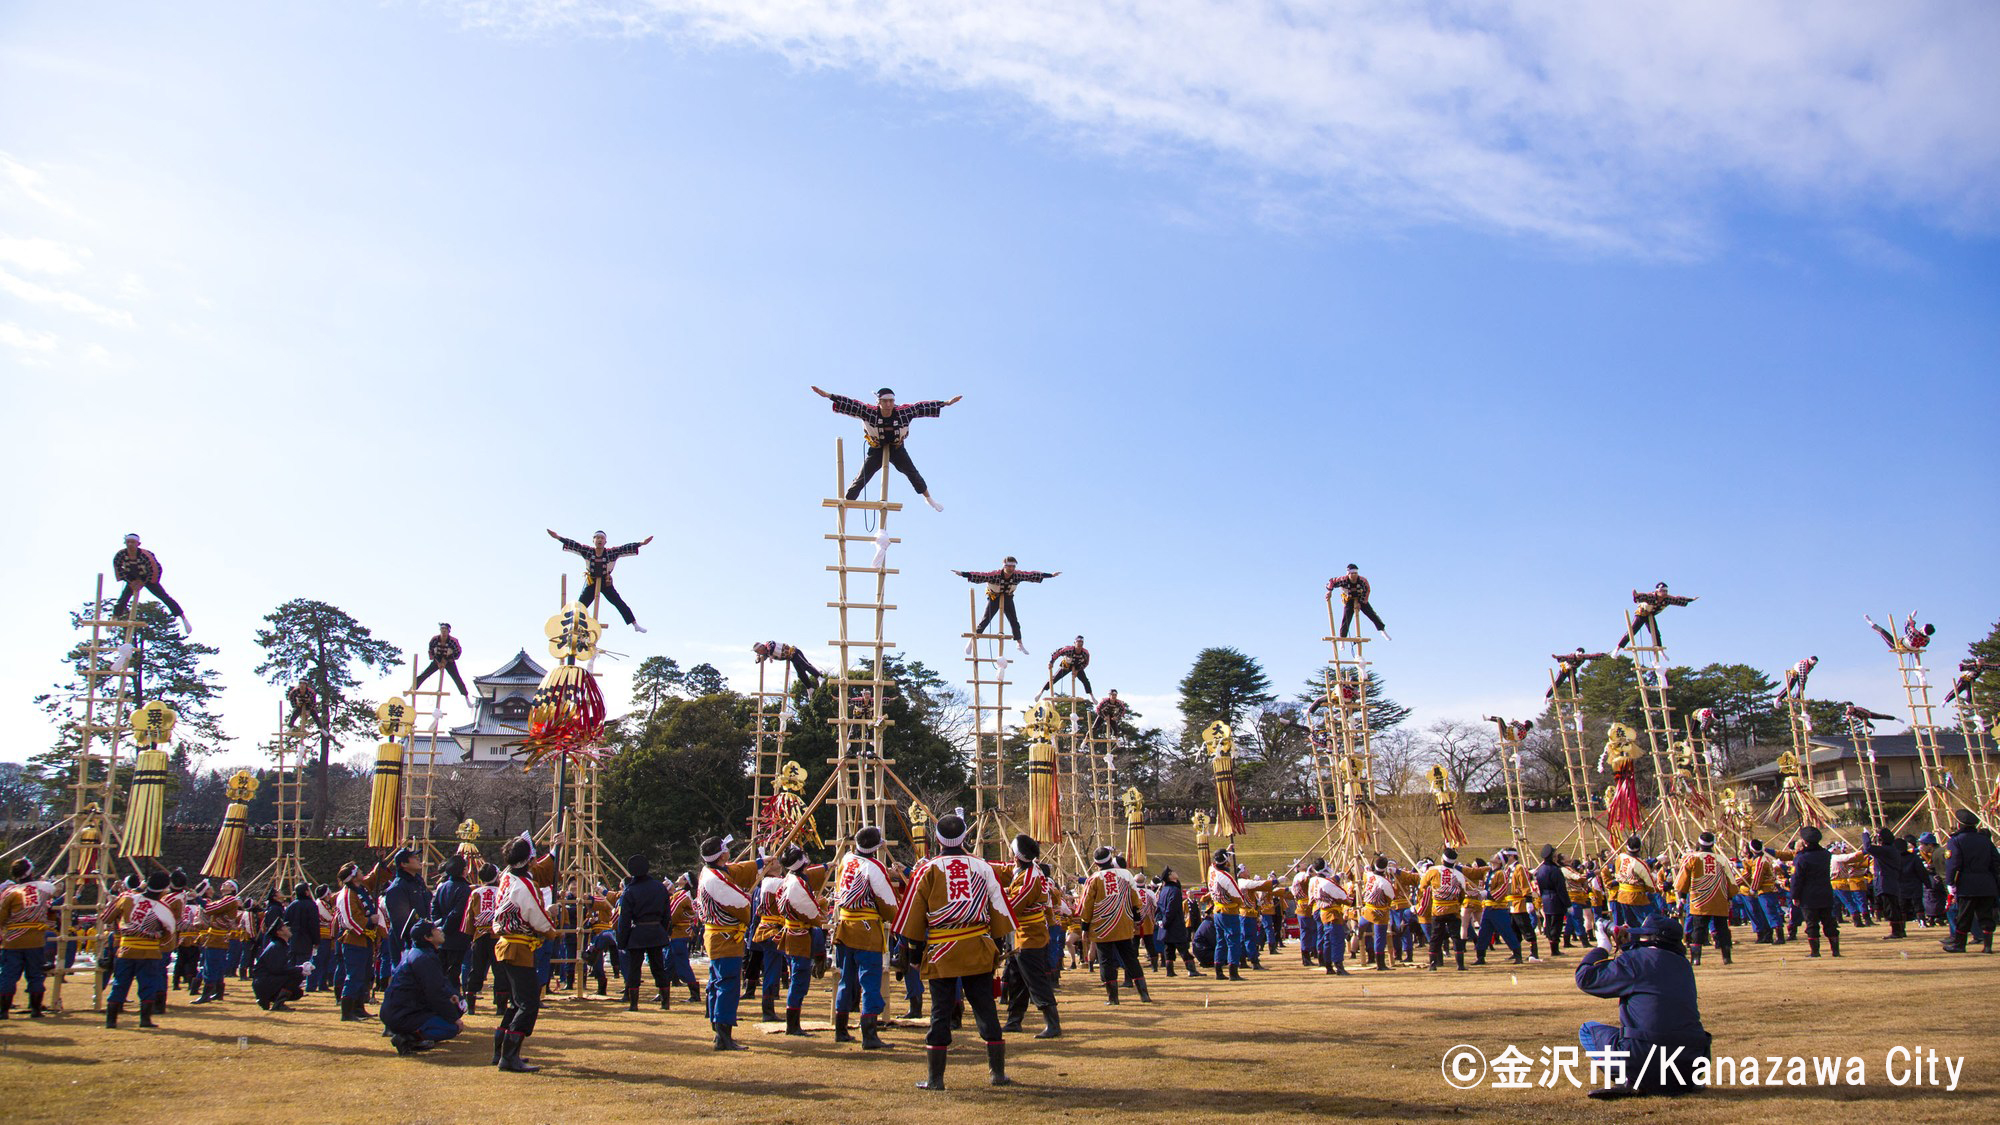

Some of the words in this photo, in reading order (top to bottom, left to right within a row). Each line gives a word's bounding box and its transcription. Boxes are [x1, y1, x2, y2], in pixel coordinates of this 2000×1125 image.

[388, 704, 404, 732] 鞍月
[841, 858, 860, 890] 金沢
[1703, 854, 1716, 875] 金沢
[946, 859, 970, 900] 金沢
[1103, 871, 1118, 895] 金沢
[1442, 868, 1453, 887] 金沢
[24, 885, 39, 907] 金沢
[482, 889, 494, 912] 金沢
[132, 900, 152, 924] 金沢
